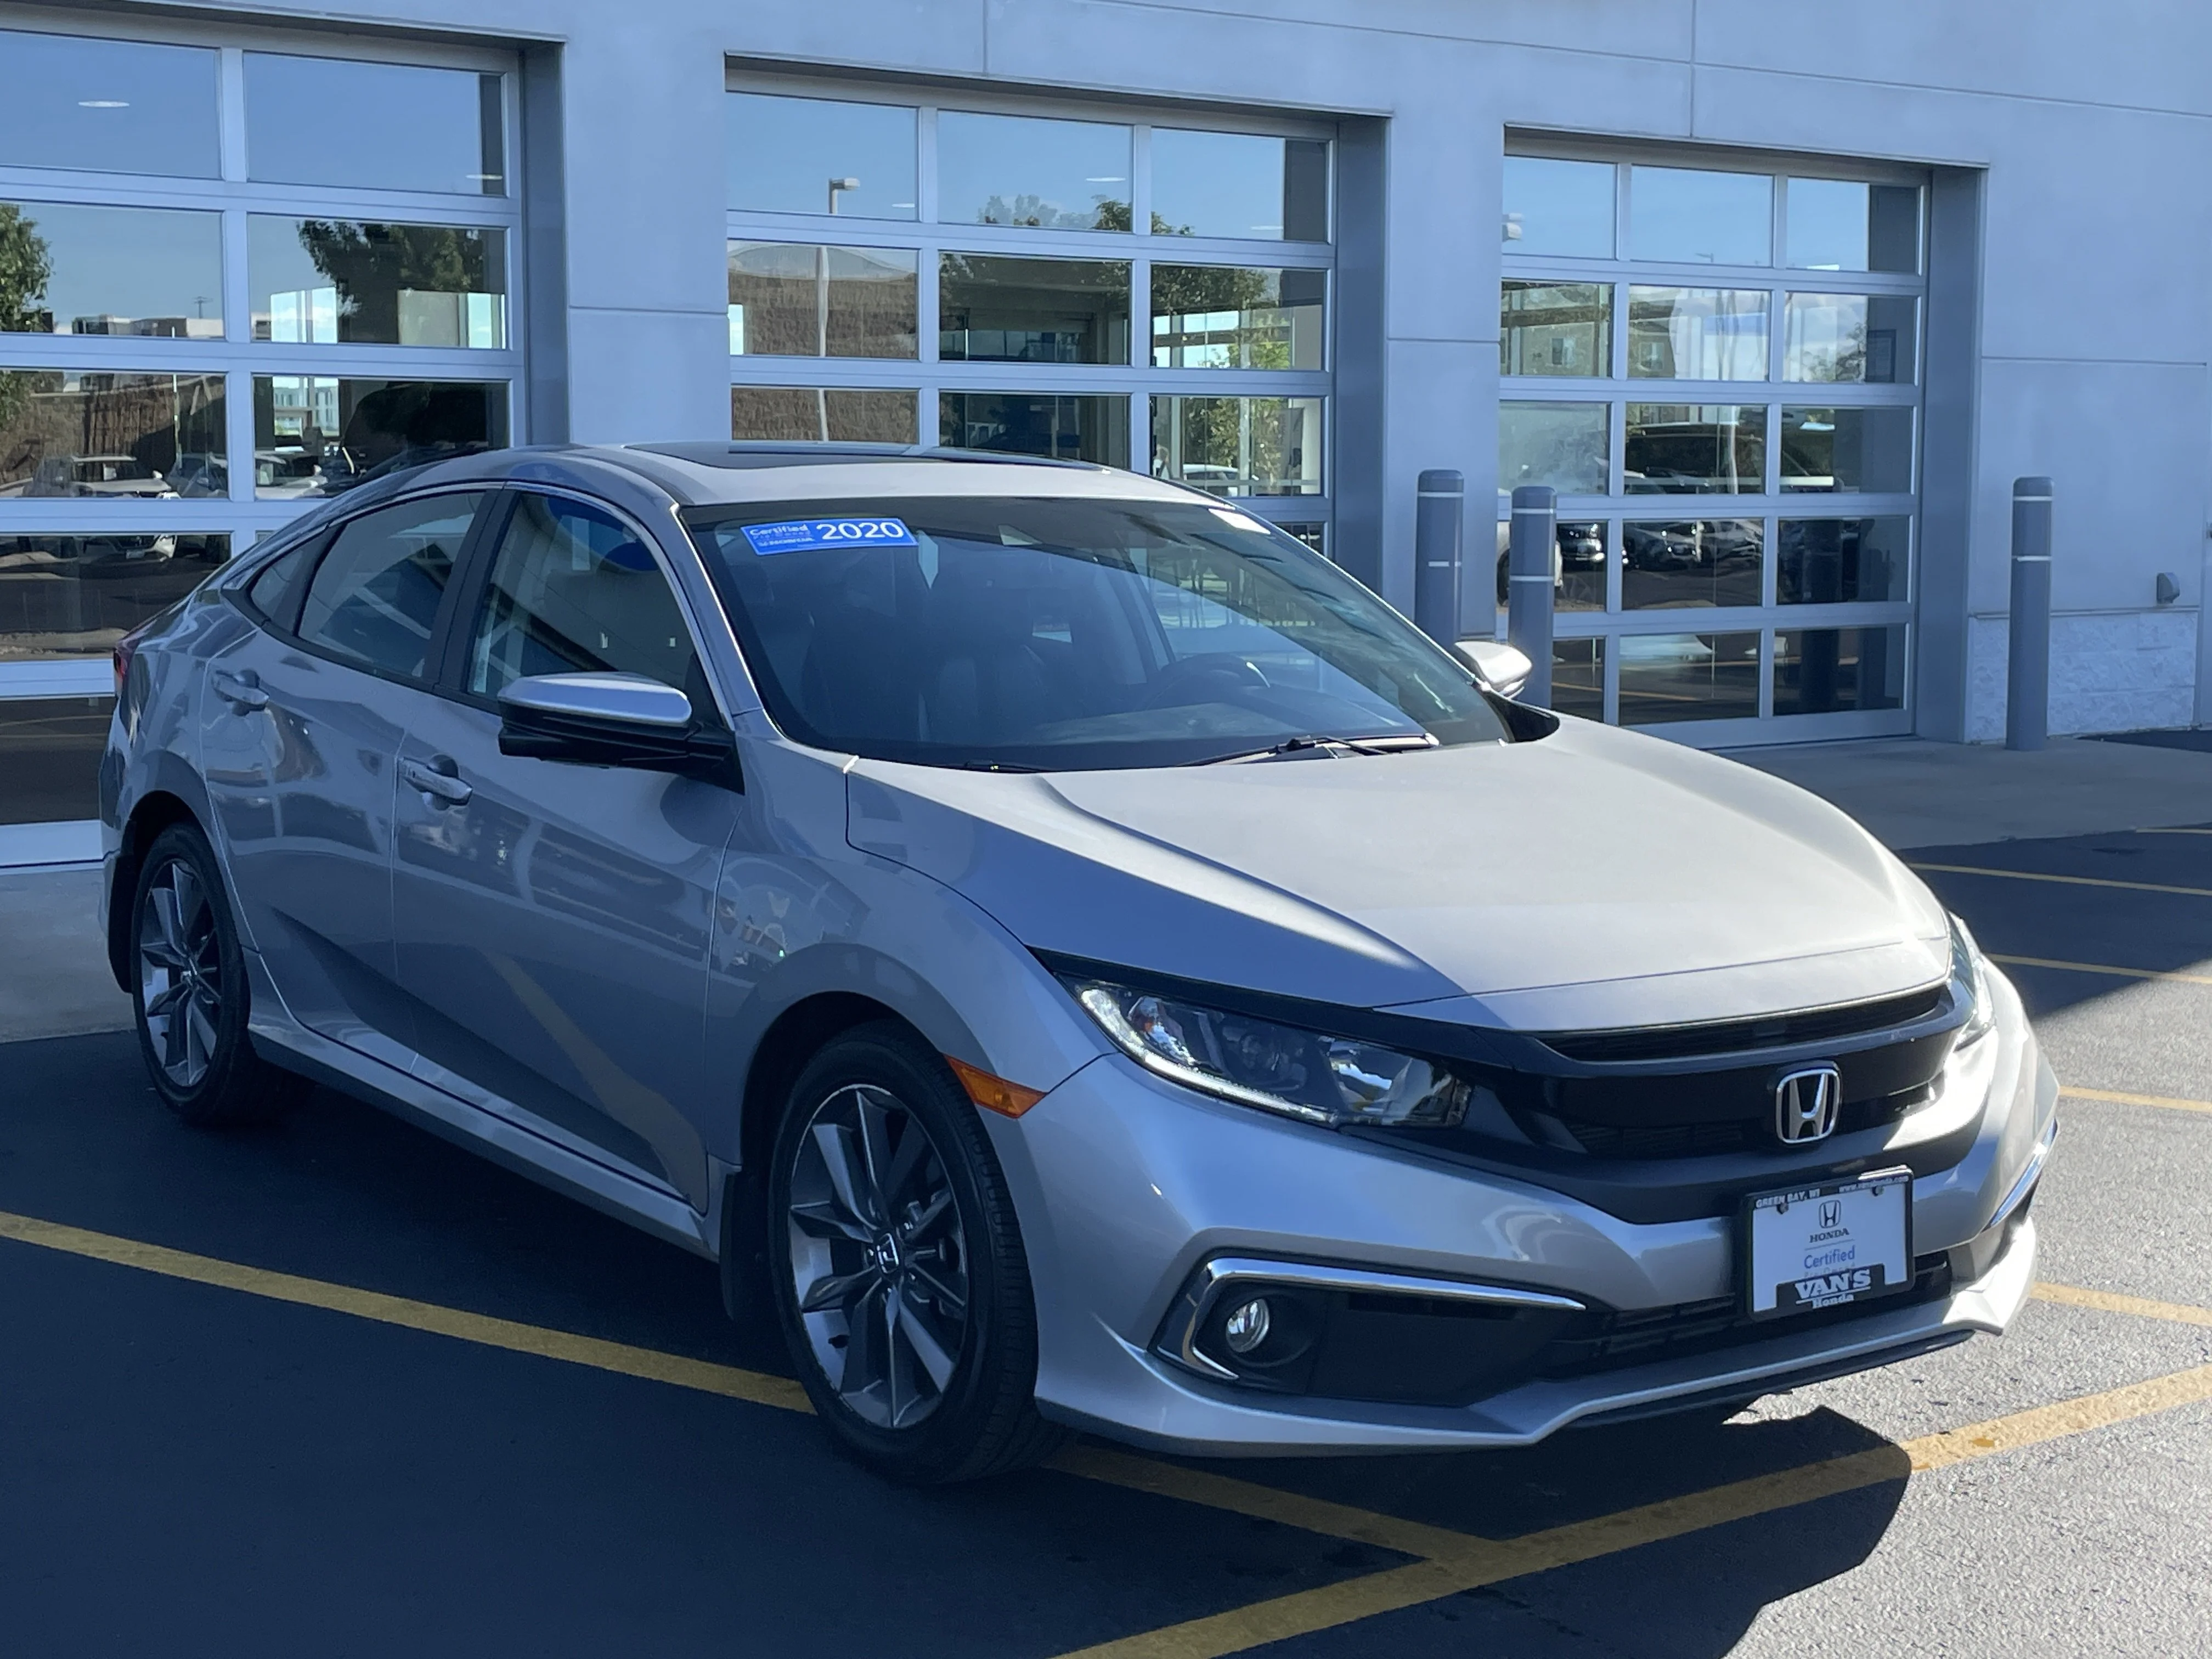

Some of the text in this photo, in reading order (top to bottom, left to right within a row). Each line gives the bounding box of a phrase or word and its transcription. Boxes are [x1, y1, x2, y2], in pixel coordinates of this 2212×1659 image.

[750, 524, 808, 536] Certified
[816, 522, 904, 540] 2020
[1756, 1195, 1785, 1208] GREEN
[1809, 1228, 1850, 1243] HONDA
[1804, 1245, 1855, 1269] Certified
[1812, 1293, 1854, 1309] Honda
